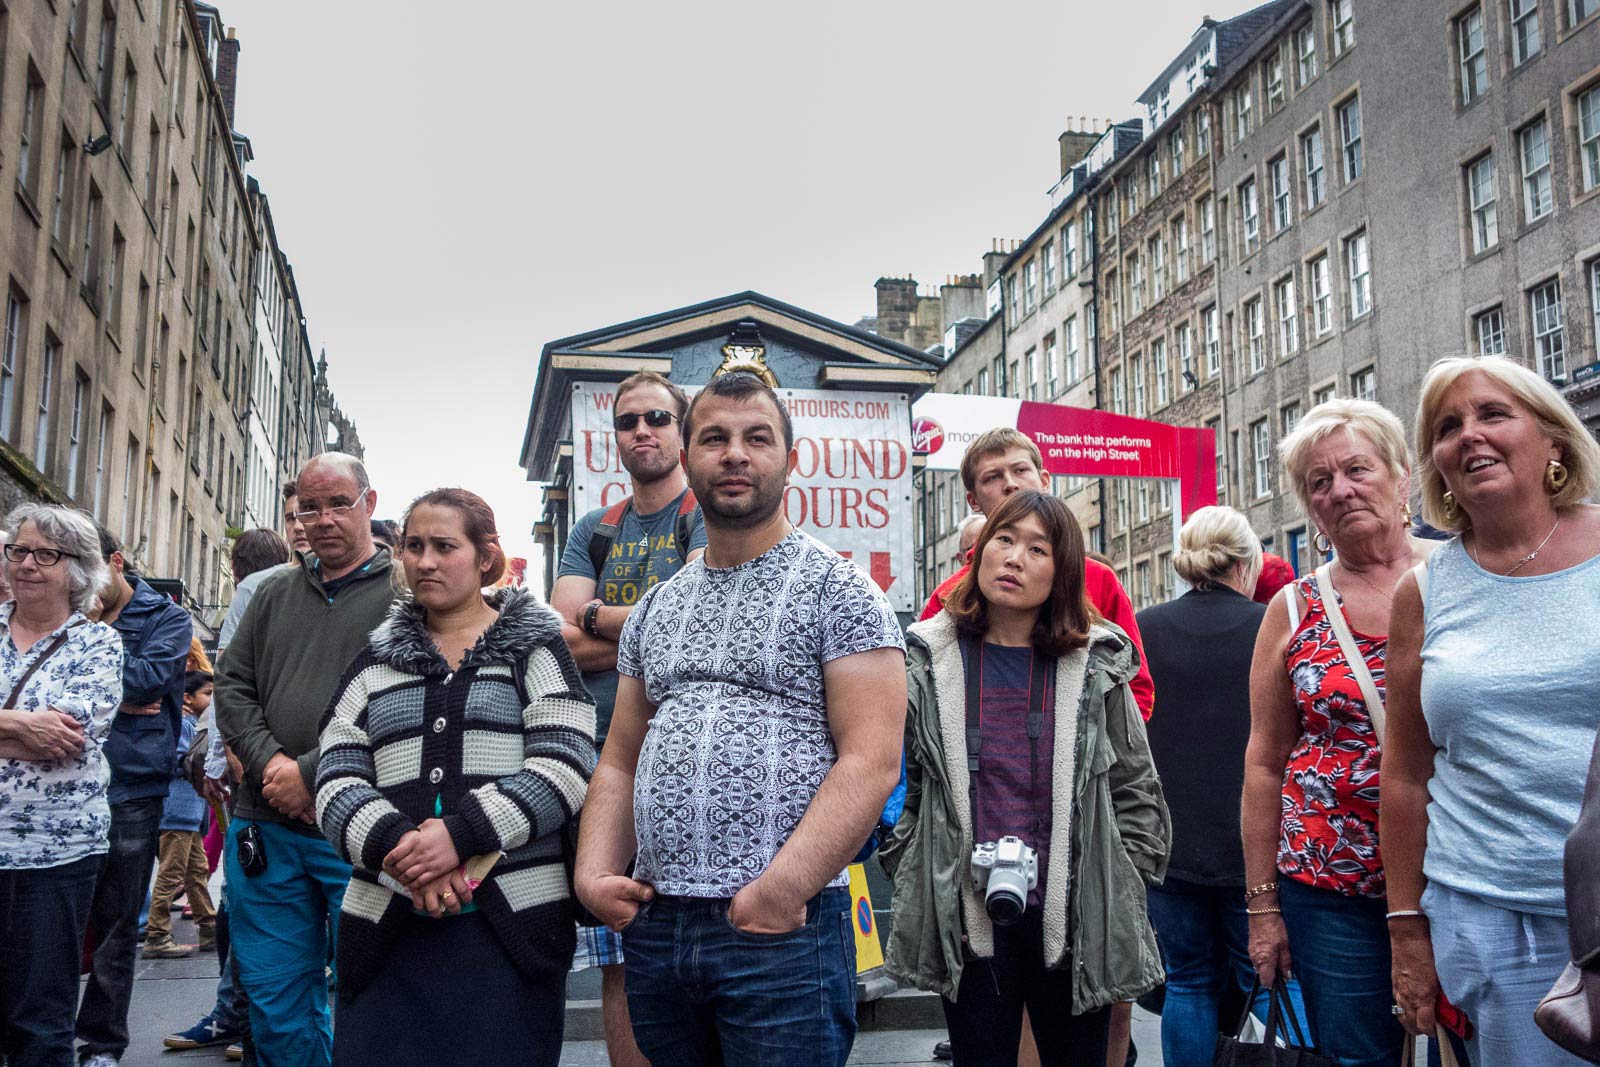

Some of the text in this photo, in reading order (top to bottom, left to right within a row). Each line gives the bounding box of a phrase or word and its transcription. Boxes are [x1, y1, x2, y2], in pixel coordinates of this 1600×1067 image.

[785, 398, 890, 419] HTOURS.COM
[1034, 431, 1152, 448] The bank that performs
[794, 436, 907, 480] OUND
[1048, 447, 1140, 462] on the High Street
[782, 485, 890, 529] OURS
[614, 565, 631, 577] OF
